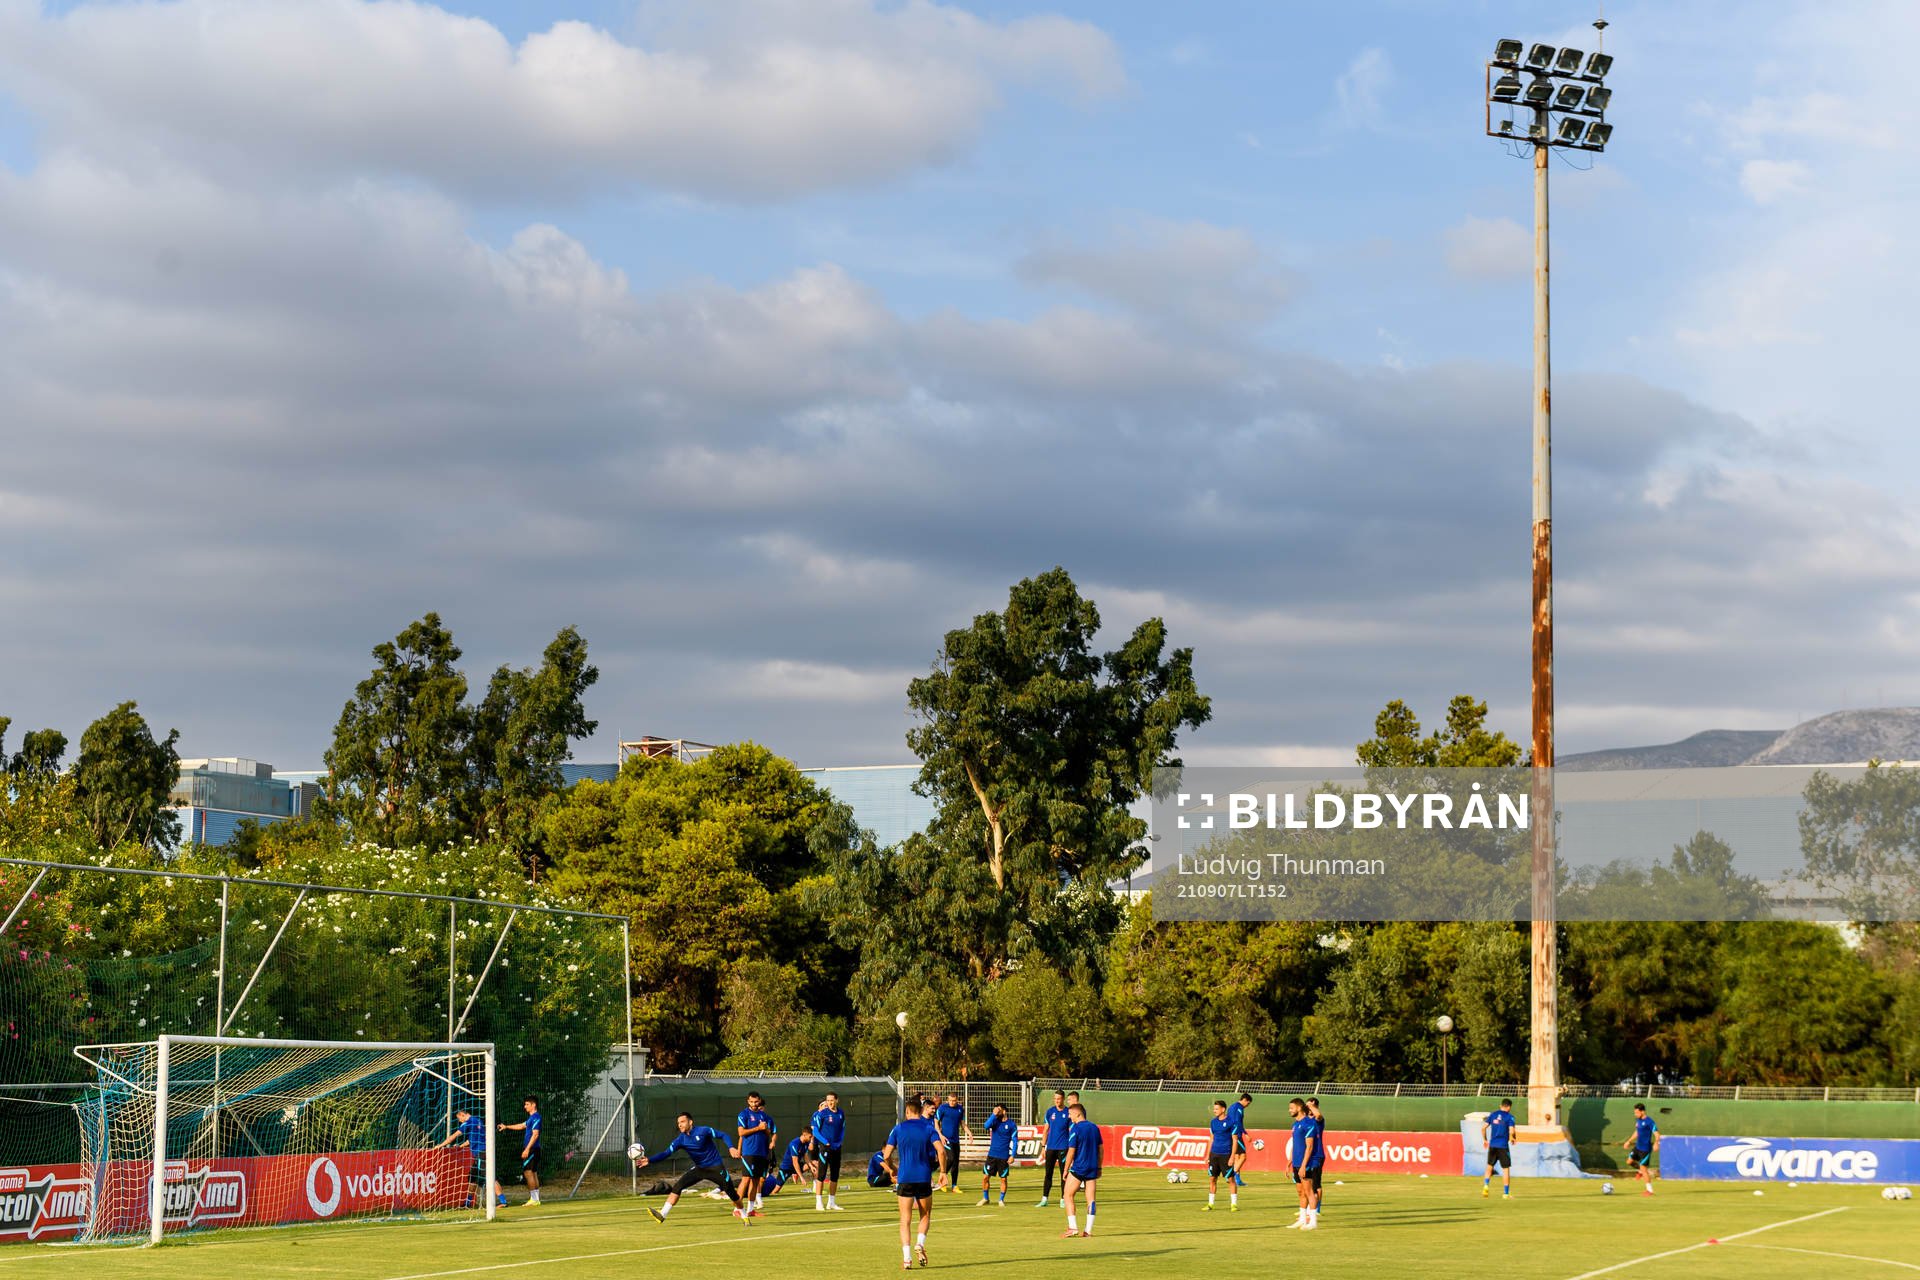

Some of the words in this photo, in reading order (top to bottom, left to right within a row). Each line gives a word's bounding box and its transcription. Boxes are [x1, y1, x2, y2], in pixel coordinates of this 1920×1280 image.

[1327, 1141, 1431, 1162] vodafone
[1736, 1150, 1878, 1179] avance
[346, 1165, 437, 1198] vodafone
